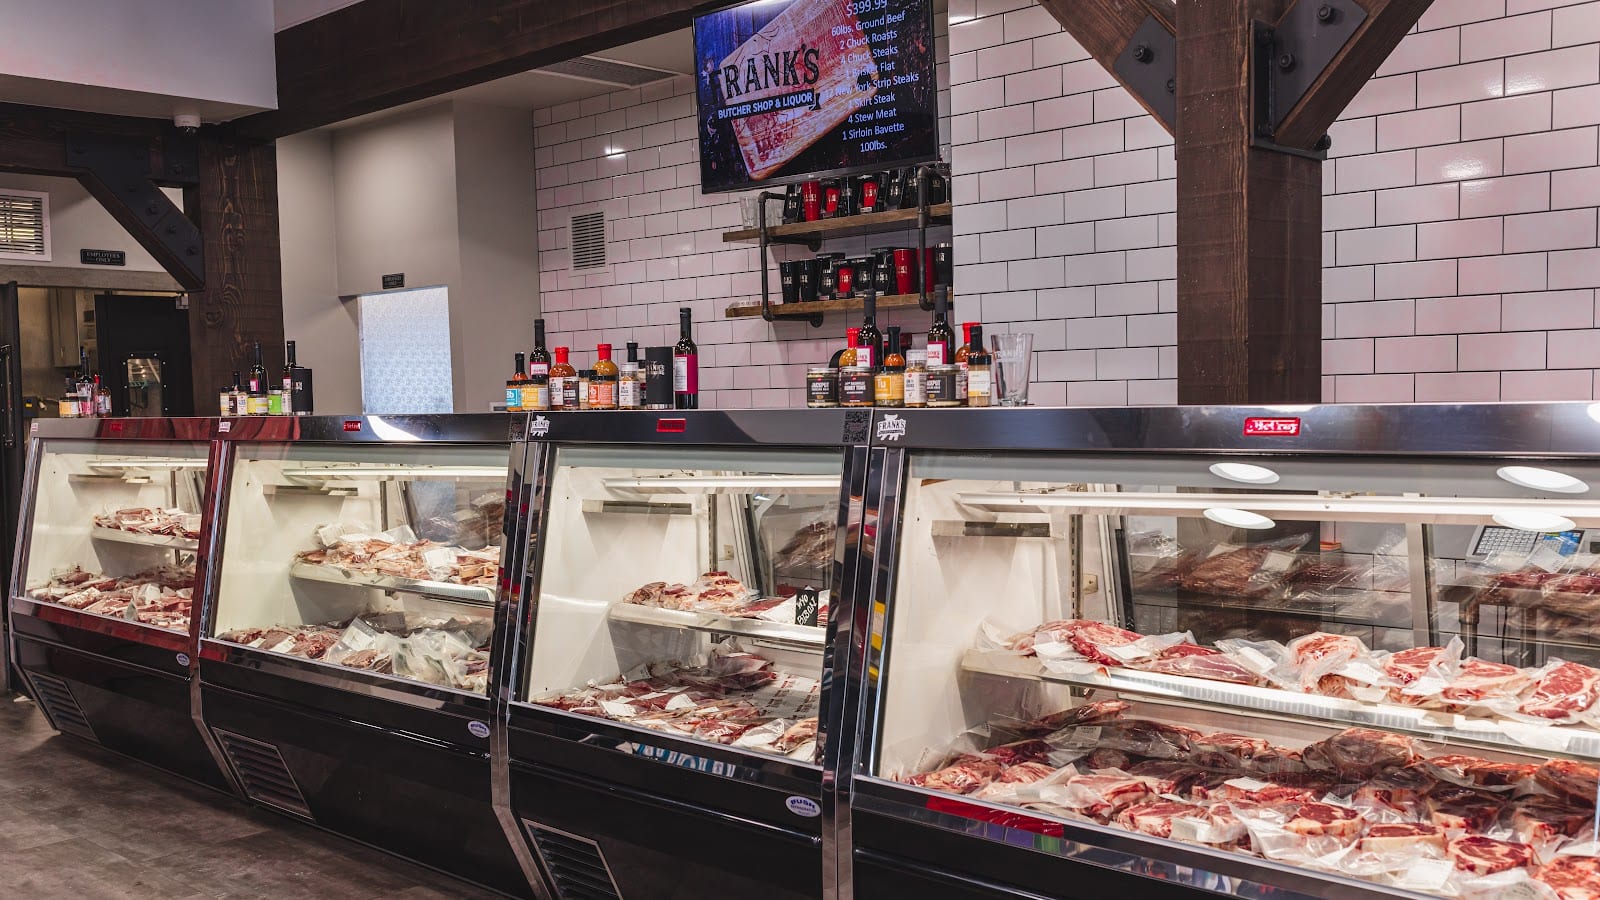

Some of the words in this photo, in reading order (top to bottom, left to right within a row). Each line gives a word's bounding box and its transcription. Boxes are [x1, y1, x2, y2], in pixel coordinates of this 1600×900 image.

[846, 0, 887, 18] $399.99
[831, 25, 853, 36] 60lbs.
[855, 15, 885, 30] Ground
[887, 10, 905, 24] Beef
[840, 40, 845, 50] 2
[846, 35, 870, 49] Chuck
[871, 30, 897, 42] Roasts
[848, 50, 870, 62] Chuck
[872, 45, 898, 58] Steaks
[709, 44, 820, 104] FRANK'S
[880, 61, 895, 72] Flat
[835, 86, 852, 96] New
[855, 81, 871, 92] York
[872, 77, 892, 89] Strip
[893, 72, 919, 85] Steaks
[718, 104, 751, 119] BUTCHER
[752, 100, 773, 113] SHOP
[775, 99, 781, 109] &
[782, 92, 813, 107] LIQUOR
[856, 97, 872, 107] Skirt
[873, 91, 896, 104] Steak
[848, 114, 853, 124] 4
[854, 112, 874, 123] Stew
[875, 107, 897, 120] Meat
[842, 130, 847, 140] 1
[848, 127, 873, 139] Sirloin
[874, 122, 905, 135] Bavette
[860, 140, 887, 152] 100lbs.
[86, 251, 120, 259] EMPLOYEES
